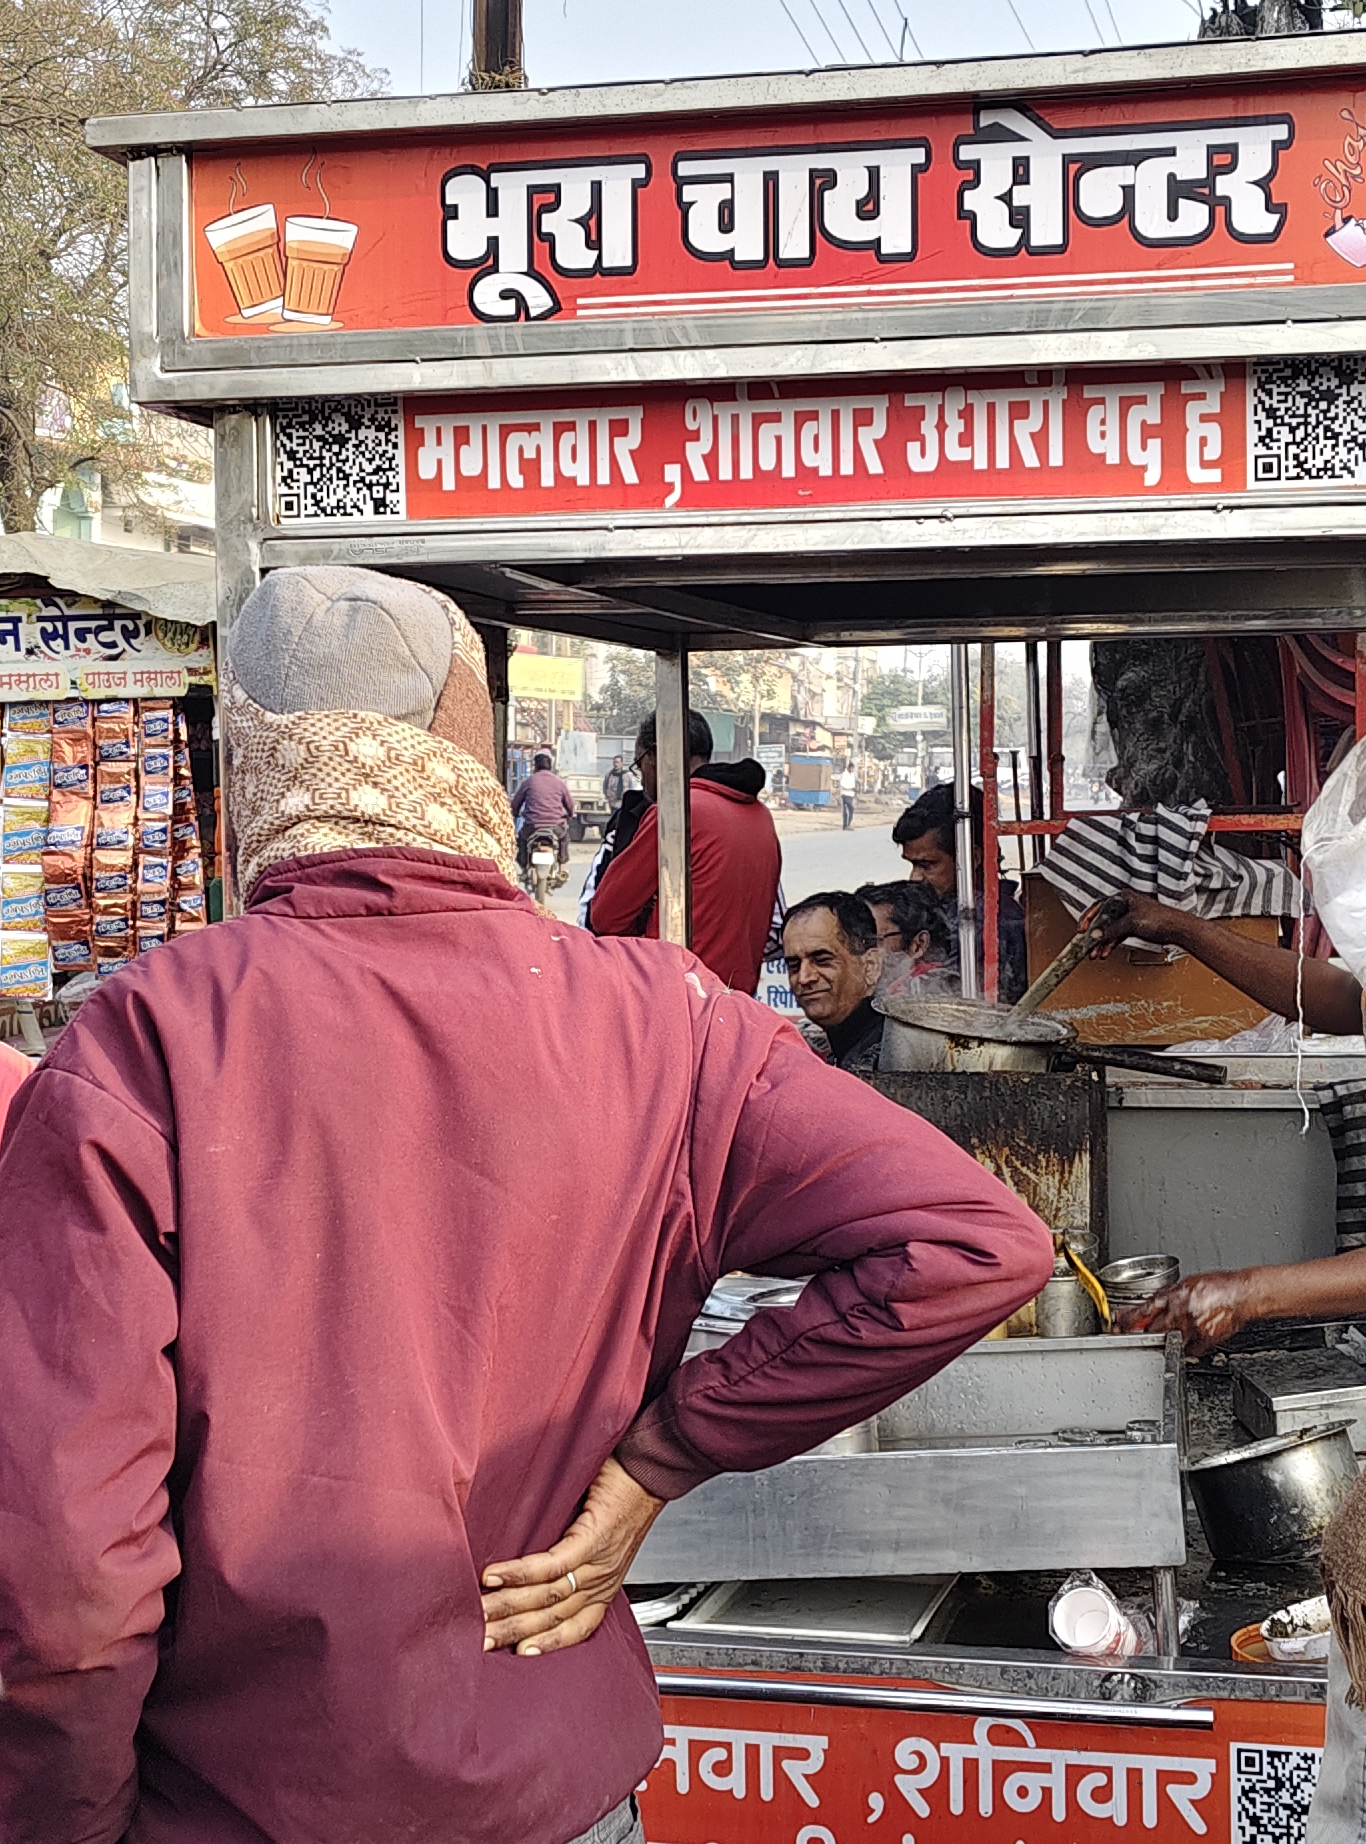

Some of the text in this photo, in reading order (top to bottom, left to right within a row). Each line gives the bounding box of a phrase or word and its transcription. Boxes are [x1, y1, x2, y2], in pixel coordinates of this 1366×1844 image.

[442, 103, 1293, 323] भूरा चाय सेन्टर
[904, 369, 1068, 472] उधारी
[37, 600, 145, 658] सेन्टर
[132, 669, 182, 689] मसाला
